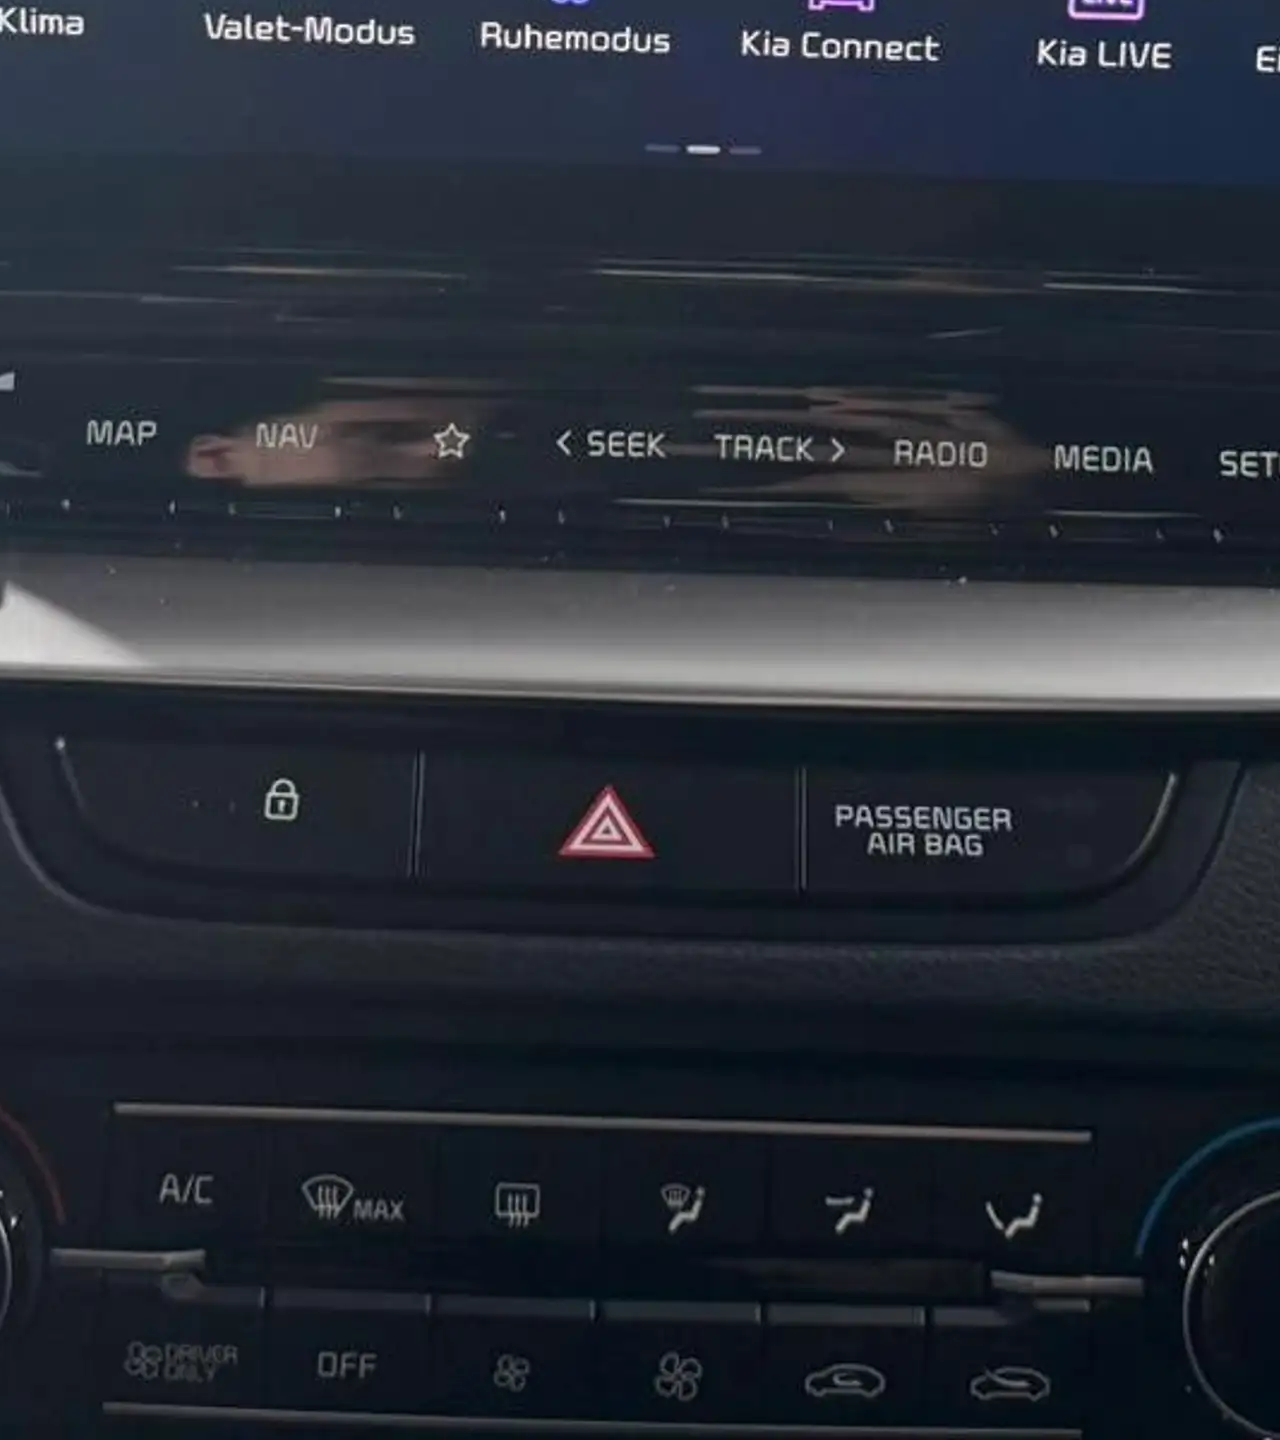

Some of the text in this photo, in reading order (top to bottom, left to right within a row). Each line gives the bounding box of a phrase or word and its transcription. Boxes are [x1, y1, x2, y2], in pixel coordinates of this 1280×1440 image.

[204, 12, 415, 45] Valet-Modus
[481, 21, 670, 54] Ruhemodus
[741, 30, 940, 62] Kia Connect
[1037, 39, 1172, 69] Kia LIVE
[87, 419, 157, 446] MAP
[256, 423, 318, 449] NAV
[587, 430, 666, 458] SEEK
[714, 433, 814, 462] TRACK
[894, 439, 988, 468] RADIO
[1054, 444, 1153, 473] MEDIA
[835, 805, 1012, 831] PASSENGER
[867, 832, 983, 856] AIR BAG
[159, 1173, 213, 1205] A/C
[353, 1199, 403, 1220] MAX
[317, 1351, 377, 1378] OFF
